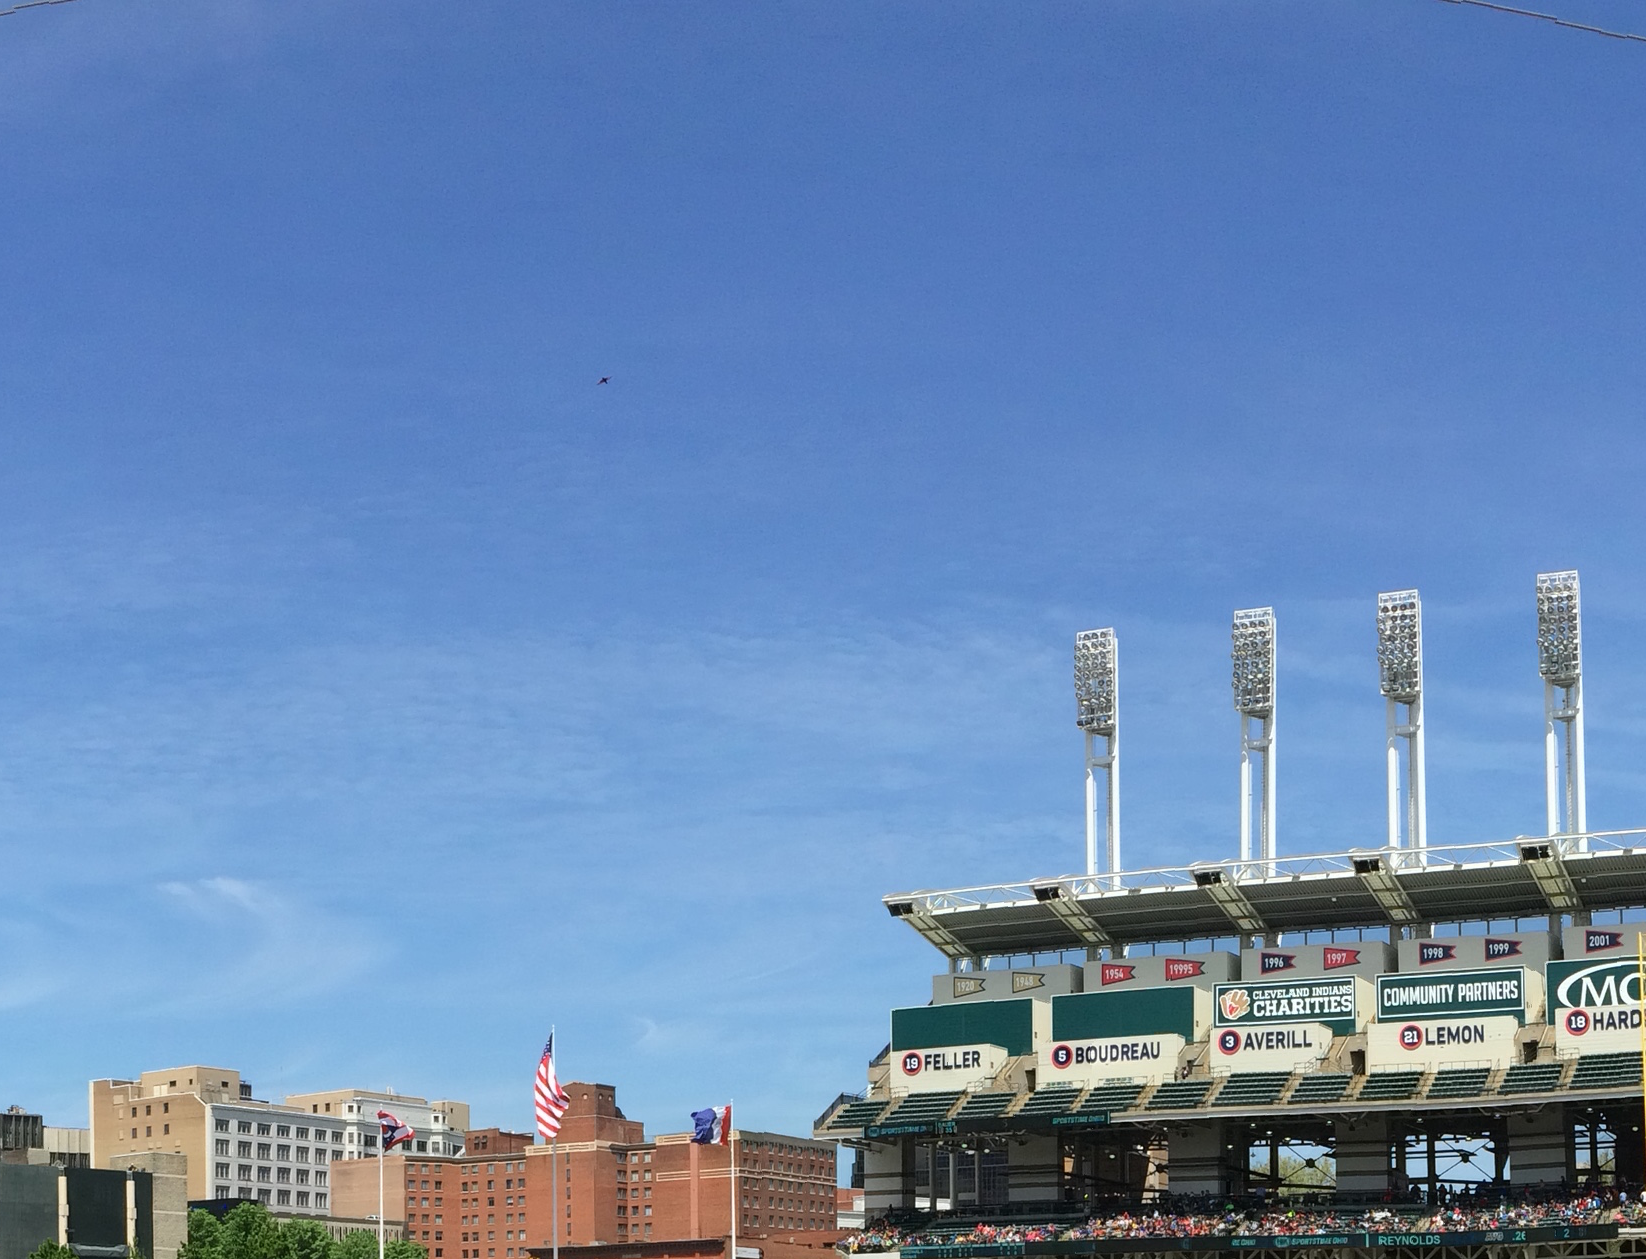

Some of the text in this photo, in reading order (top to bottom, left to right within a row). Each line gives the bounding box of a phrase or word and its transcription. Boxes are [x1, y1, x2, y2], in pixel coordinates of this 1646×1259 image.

[1589, 935, 1611, 947] 2001
[1423, 947, 1444, 959] 1998
[1489, 943, 1510, 955] 1999
[1264, 957, 1284, 969] 1996
[1326, 952, 1347, 964] 1997
[1105, 968, 1124, 980] 1954
[956, 980, 975, 992] 1920
[1015, 976, 1034, 987] 1948
[1252, 984, 1352, 1000] CLEVELAND INDIANS
[1383, 980, 1519, 1007] COMMUNITY PARTNERS
[1254, 995, 1353, 1018] CHARITIES
[1570, 1015, 1585, 1028] 18
[1225, 1030, 1313, 1051] 3 AVERILL
[1404, 1024, 1485, 1046] 21 LEMON
[1058, 1041, 1161, 1065] 5 BOUDREAU
[905, 1050, 981, 1072] 19 FELLER
[1378, 1234, 1442, 1247] REYNOLDS
